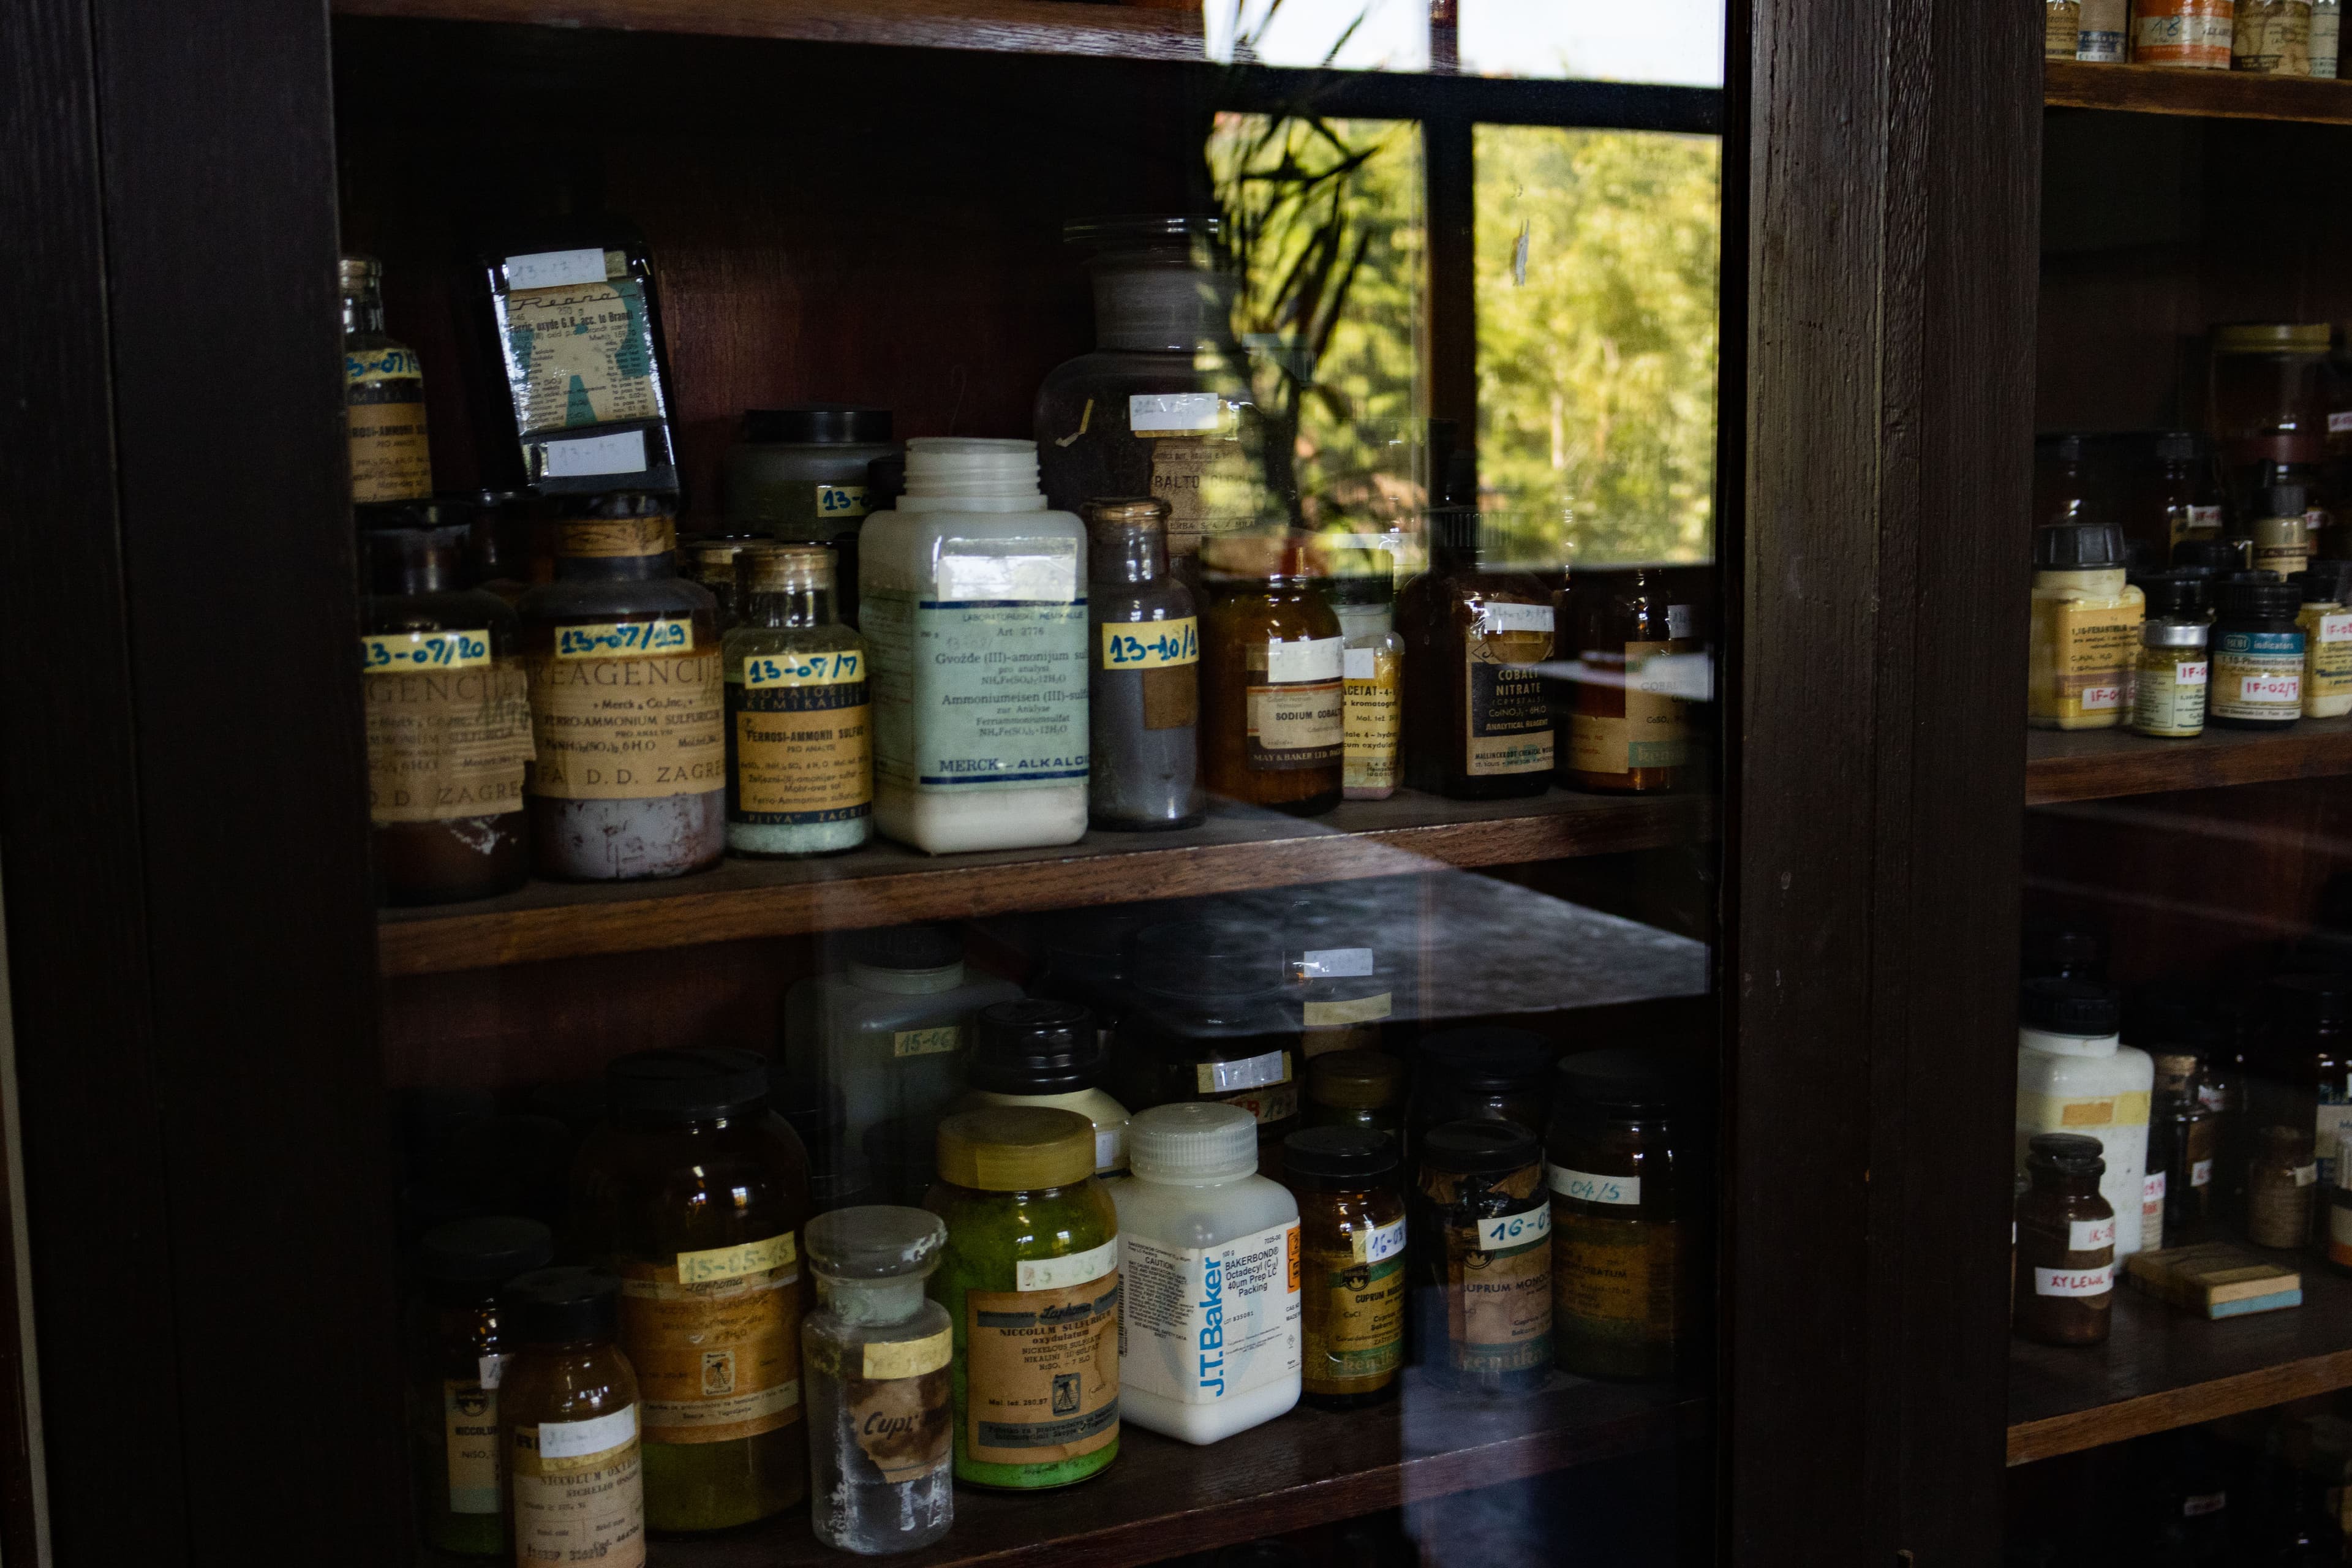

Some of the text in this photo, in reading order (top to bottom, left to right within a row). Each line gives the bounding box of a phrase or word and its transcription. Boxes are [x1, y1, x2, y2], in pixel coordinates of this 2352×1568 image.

[510, 322, 532, 333] Ferric
[537, 318, 558, 331] oxyde
[598, 313, 606, 323] to
[561, 623, 685, 654] 13-07/19
[1074, 649, 1090, 660] sul
[749, 653, 858, 683] 13-07/7
[1498, 669, 1539, 681] COBALT
[1496, 682, 1541, 696] NITRATE
[941, 688, 1090, 706] Ammoniumeisen (III)-sulf
[1275, 711, 1313, 721] SODIUM
[1486, 718, 1549, 731] ANALYTICAL REAGENT
[1284, 752, 1313, 761] BAKER
[939, 758, 1000, 773] MERCK
[1226, 1262, 1263, 1281] Octadecyl
[1250, 1273, 1267, 1284] Prep
[1268, 1267, 1278, 1278] LC
[1238, 1281, 1268, 1297] Packing
[1356, 1291, 1385, 1304] CUPRUM
[1000, 1327, 1056, 1337] NICCOLUM
[1199, 1256, 1224, 1397] J.T.Baker
[1033, 1329, 1089, 1344] oxydulatum
[1022, 1343, 1068, 1354] NICKELOUS
